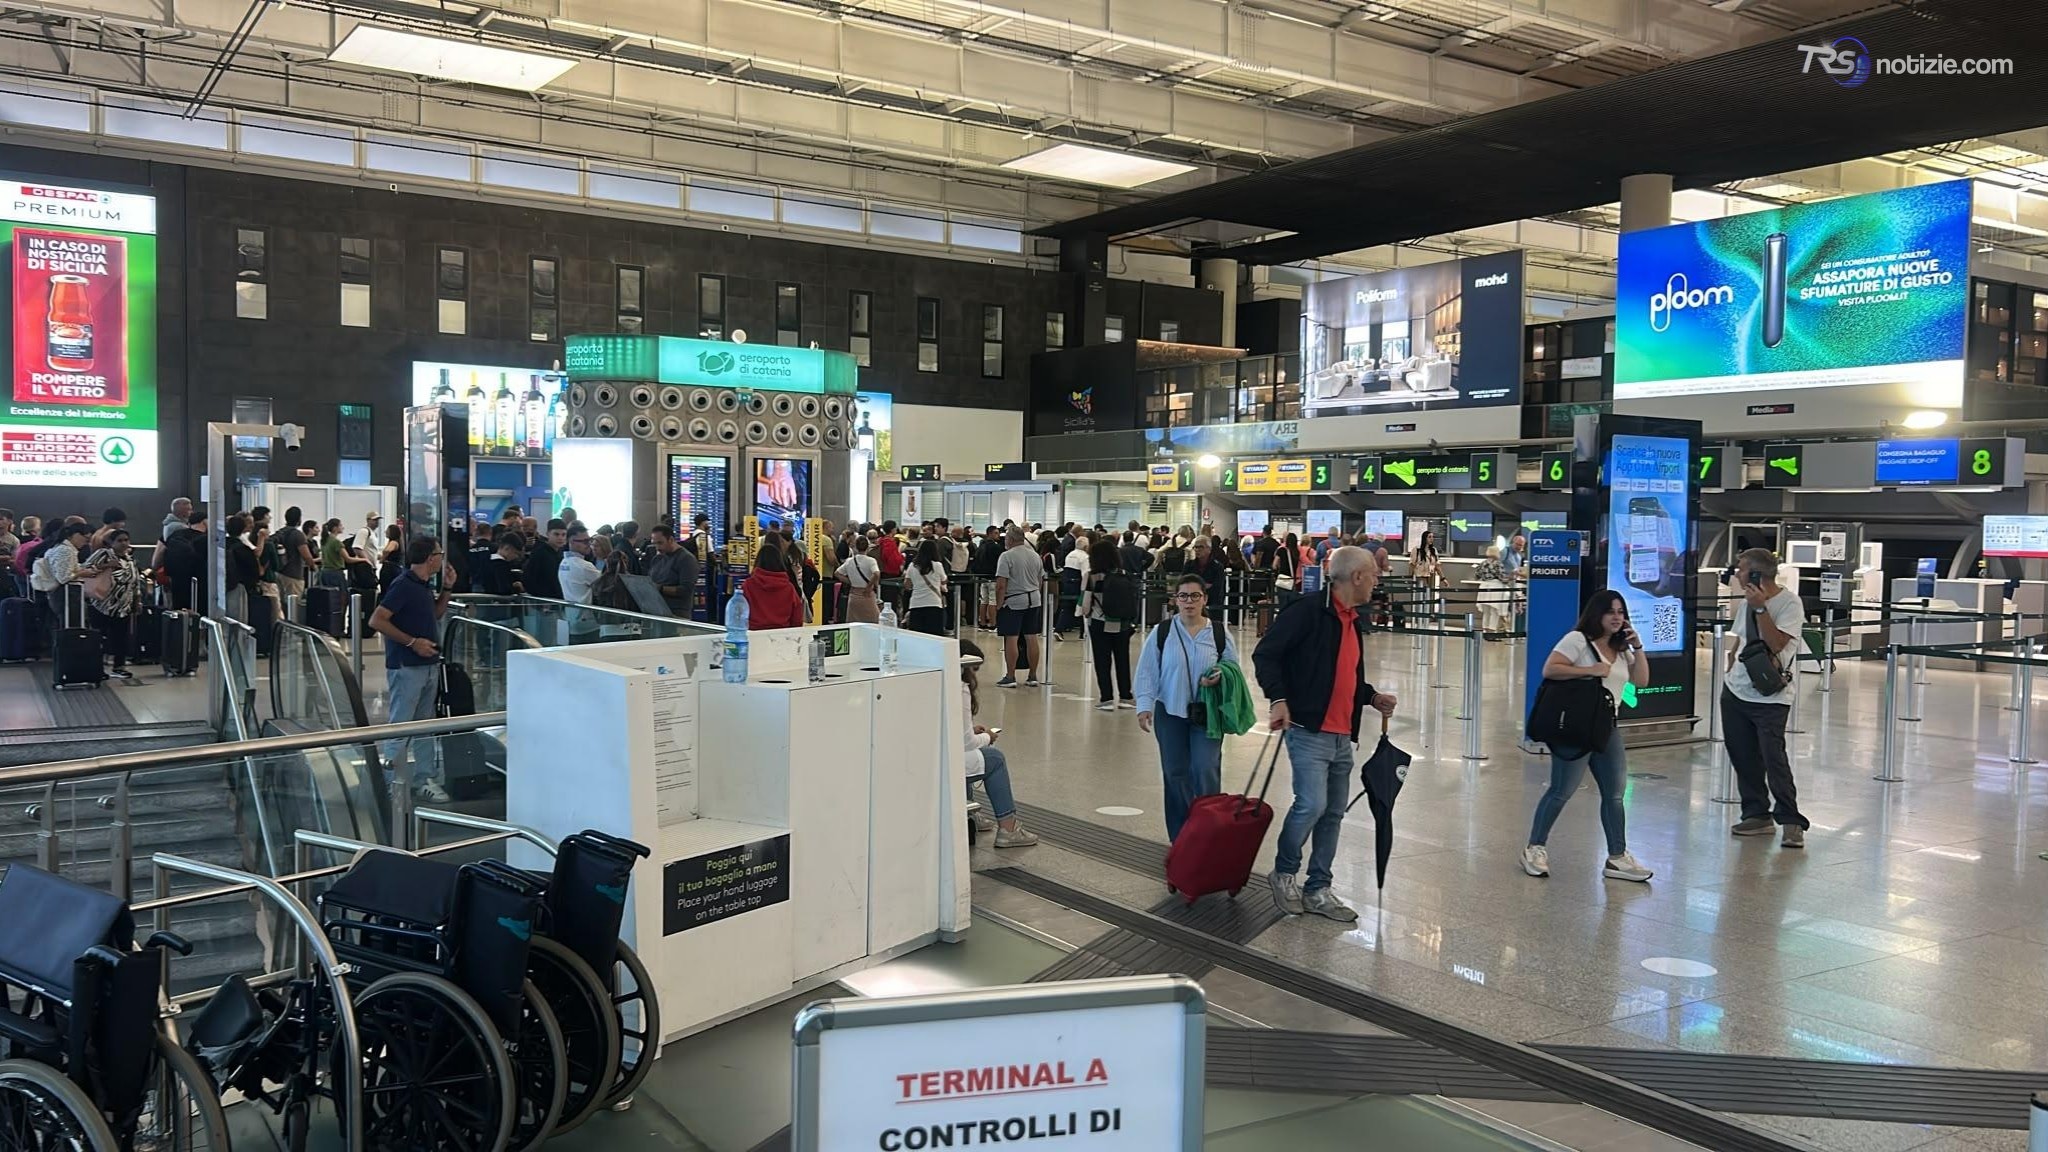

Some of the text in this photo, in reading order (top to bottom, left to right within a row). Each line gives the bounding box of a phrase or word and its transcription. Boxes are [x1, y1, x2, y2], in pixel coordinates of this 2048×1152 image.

[33, 188, 98, 202] DESPAR
[14, 201, 121, 220] PREMIUM
[29, 238, 107, 254] IN CASO DI
[28, 248, 107, 265] NOSTALGIA
[1844, 254, 1897, 267] CONSUMATORE
[28, 259, 108, 275] DI SICILIA
[1812, 259, 1939, 285] ASSAPORA NUOVE
[1475, 272, 1509, 288] mohd
[1800, 272, 1953, 300] SFUMATURE DI GUSTO
[1356, 288, 1398, 305] Poliform
[1838, 296, 1865, 307] VISITA
[571, 355, 604, 366] catania
[739, 354, 791, 366] aeroporto
[739, 364, 791, 377] di catania
[32, 373, 107, 387] ROMPERE
[32, 384, 105, 398] IL VETRO
[10, 407, 63, 417] Eccellenze
[83, 410, 126, 419] territorio
[34, 434, 96, 443] DESPAR
[12, 443, 97, 453] EUROSPAR
[1657, 449, 1680, 459] nuova
[12, 453, 96, 464] INTERSPAR
[1972, 450, 1991, 475] 8
[1316, 466, 1326, 484] 3
[1363, 465, 1375, 483] 4
[1479, 461, 1490, 481] 5
[1550, 461, 1563, 481] 6
[1700, 457, 1713, 479] 7
[1184, 470, 1190, 486] 1
[1225, 470, 1233, 486] 2
[706, 850, 753, 872] Poggia qui
[678, 883, 684, 894] il
[687, 881, 703, 892] tuo
[705, 868, 744, 888] bagaglio
[753, 861, 777, 873] mano
[677, 875, 778, 910] Place your hand luggage
[695, 895, 762, 921] on the table top
[896, 1058, 1109, 1099] TERMINAL A
[879, 1108, 1122, 1152] CONTROLLI DI
